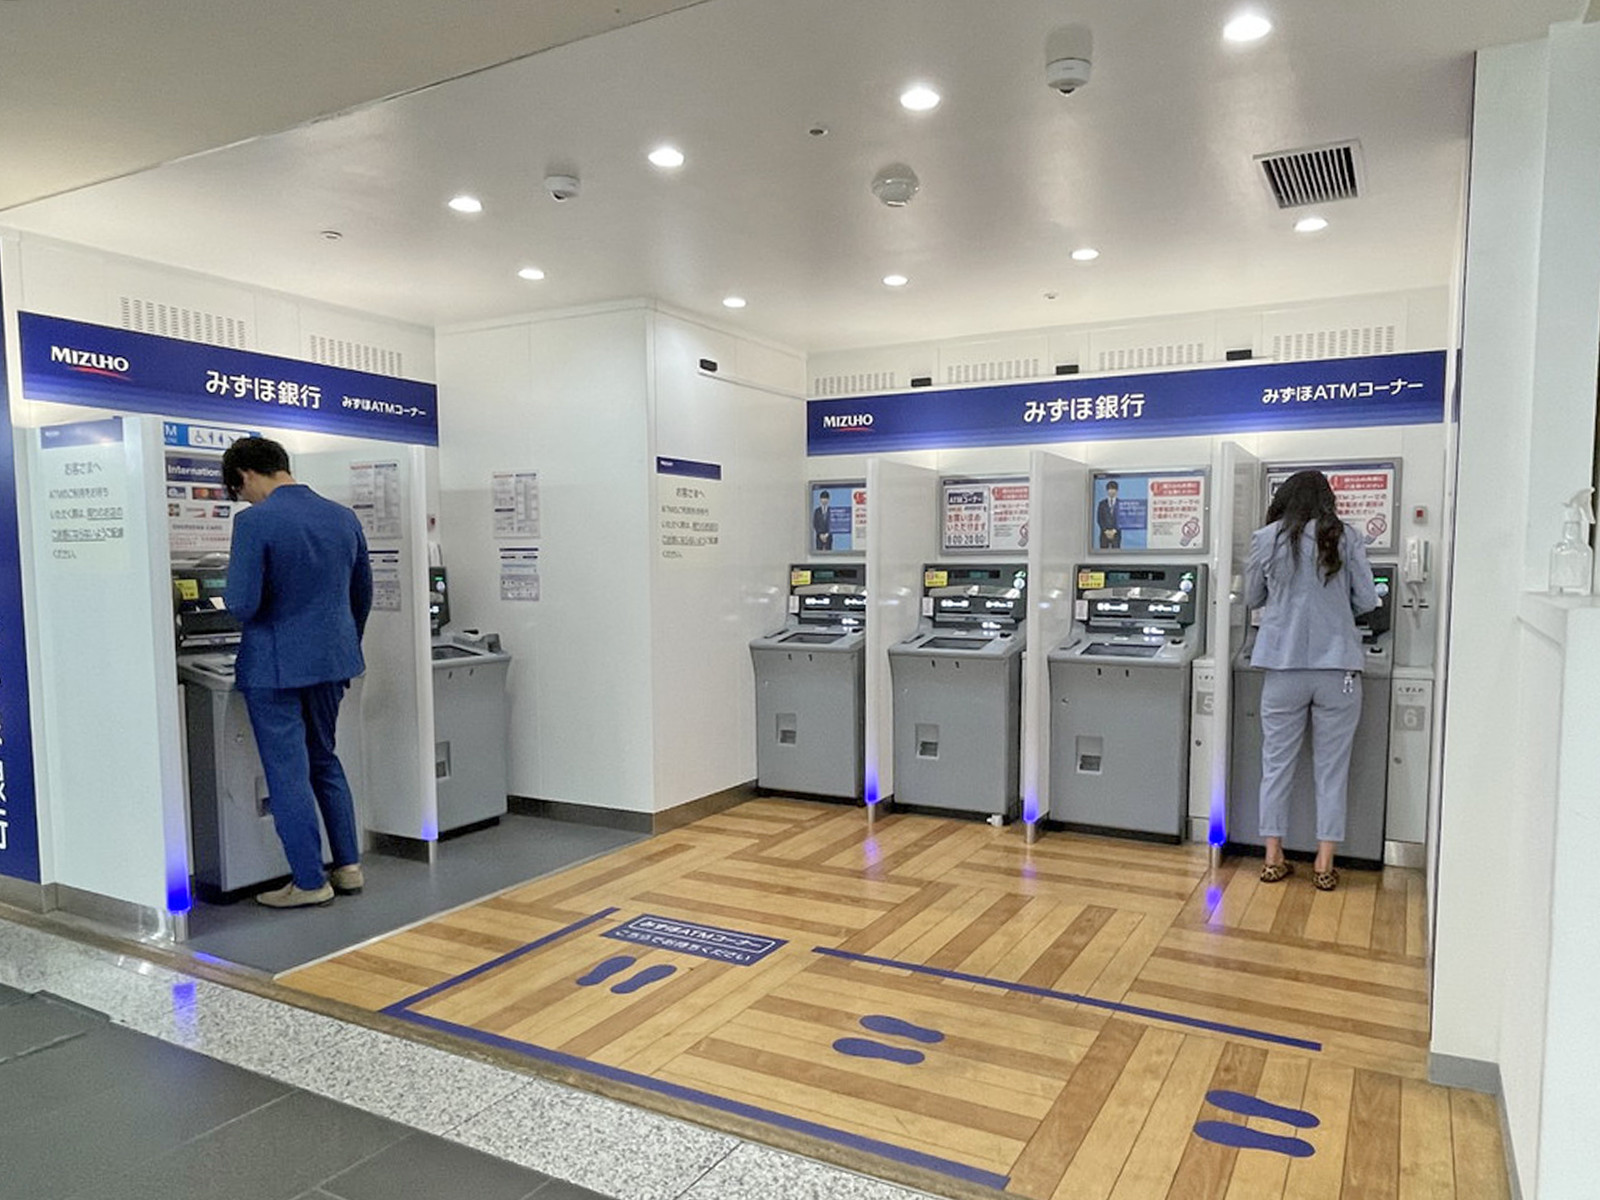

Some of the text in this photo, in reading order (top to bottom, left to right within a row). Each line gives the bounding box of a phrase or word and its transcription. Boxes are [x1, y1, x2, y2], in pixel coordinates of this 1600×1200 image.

[51, 345, 130, 372] MIZUHO
[205, 370, 322, 409] みずほ銀行
[1262, 378, 1424, 405] みずほATMコーナー
[342, 395, 427, 417] みずほATMコーナー
[1023, 393, 1145, 424] みずほ銀行
[823, 413, 874, 428] MIZUHO
[1404, 708, 1418, 728] 6
